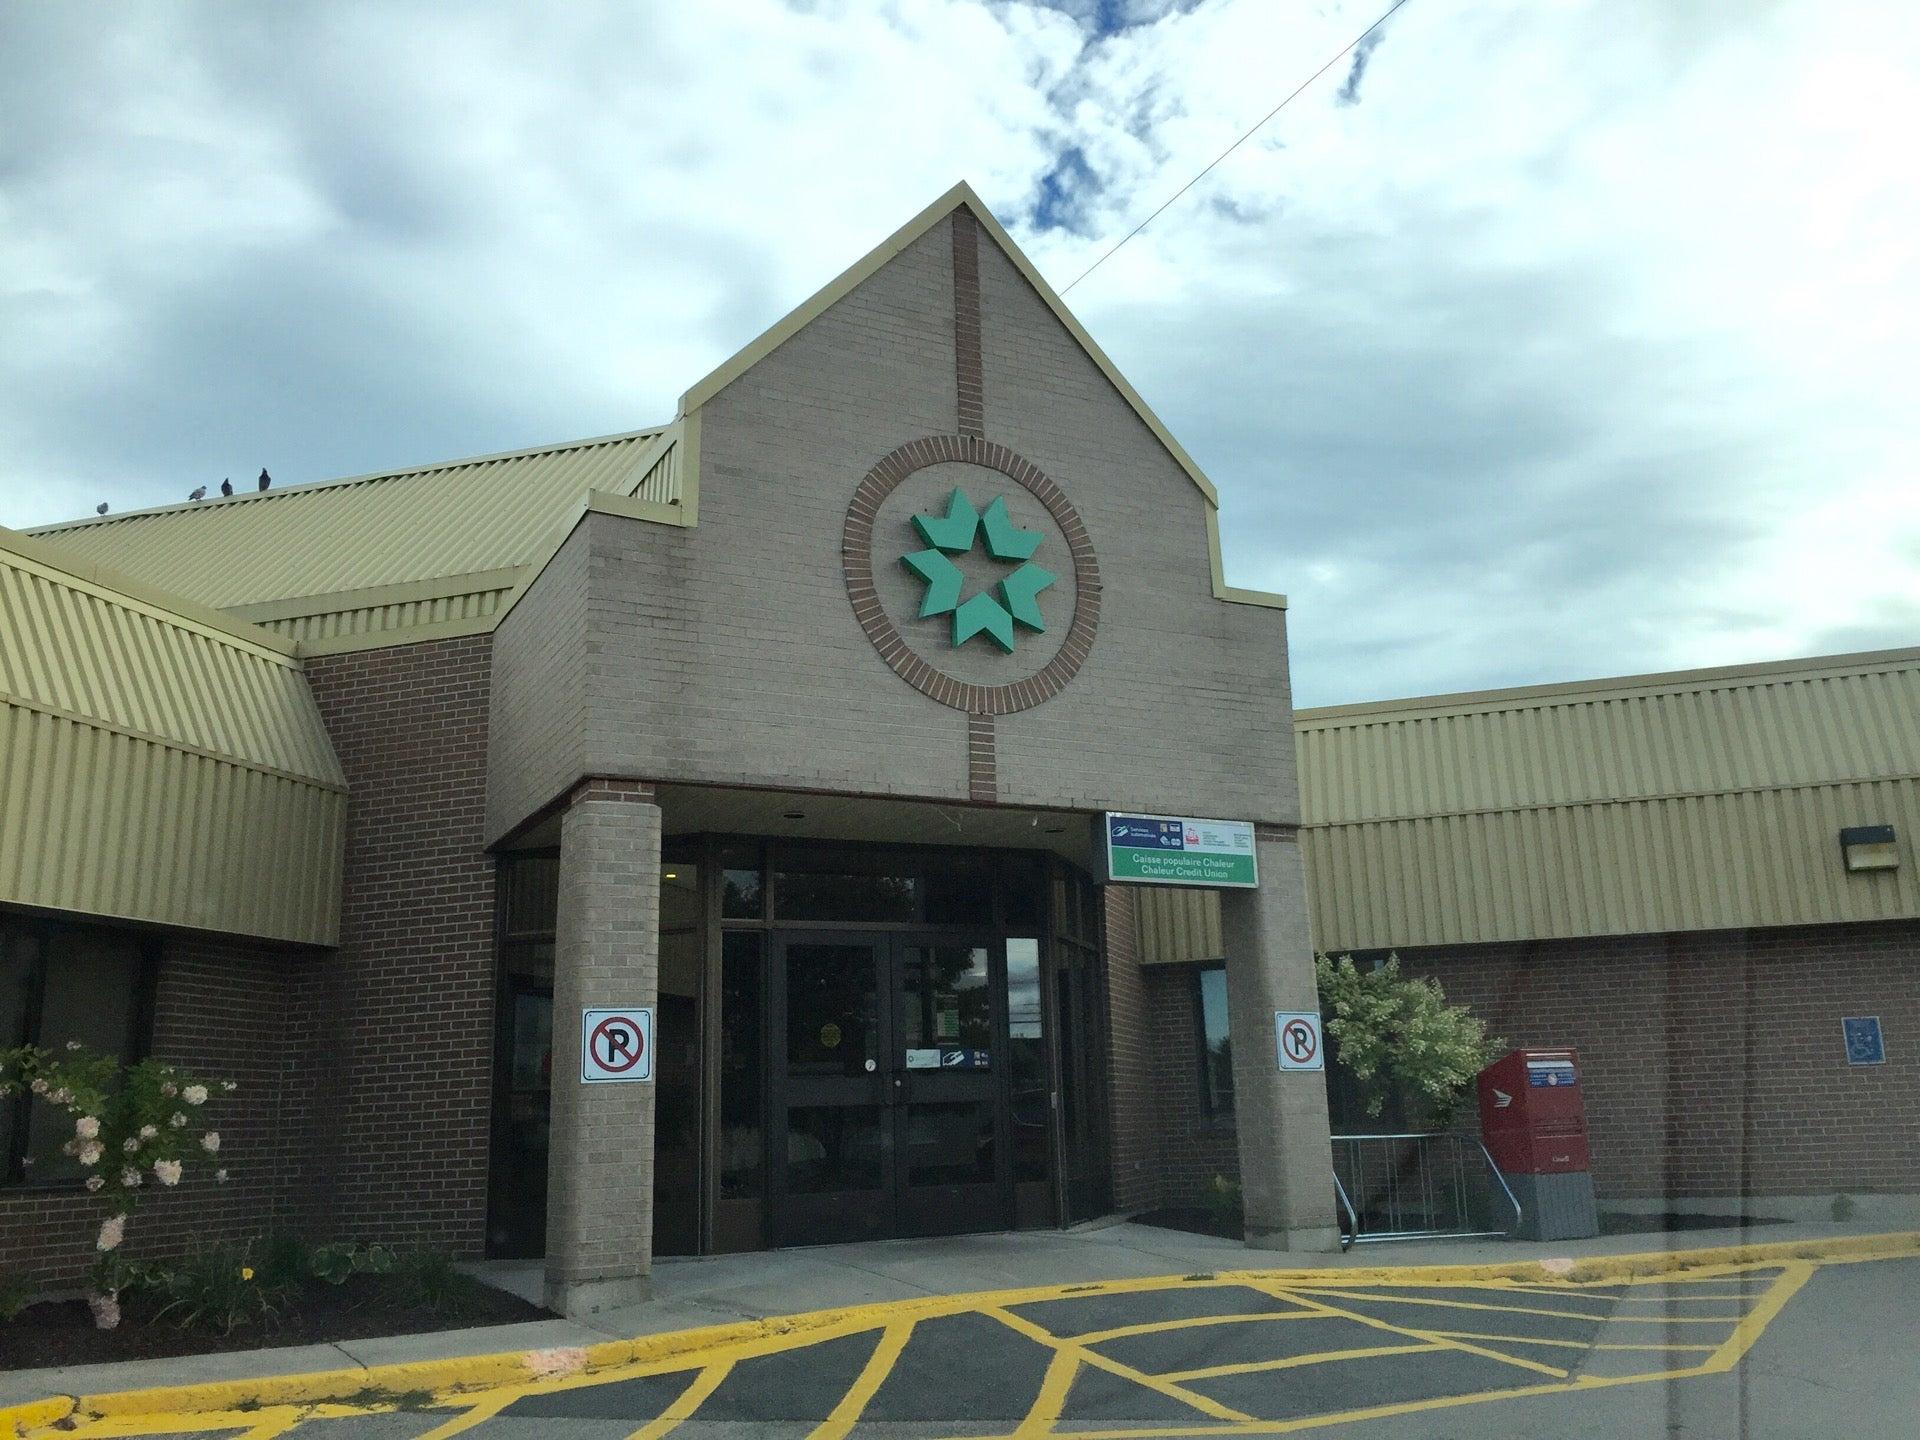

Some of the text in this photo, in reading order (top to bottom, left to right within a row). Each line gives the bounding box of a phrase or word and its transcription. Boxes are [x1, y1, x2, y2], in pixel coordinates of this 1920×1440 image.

[1132, 853, 1235, 868] Caisse populaire Chaleur
[1141, 864, 1229, 878] Chaleur Credit Union
[608, 1028, 630, 1062] P
[1294, 1028, 1307, 1055] P
